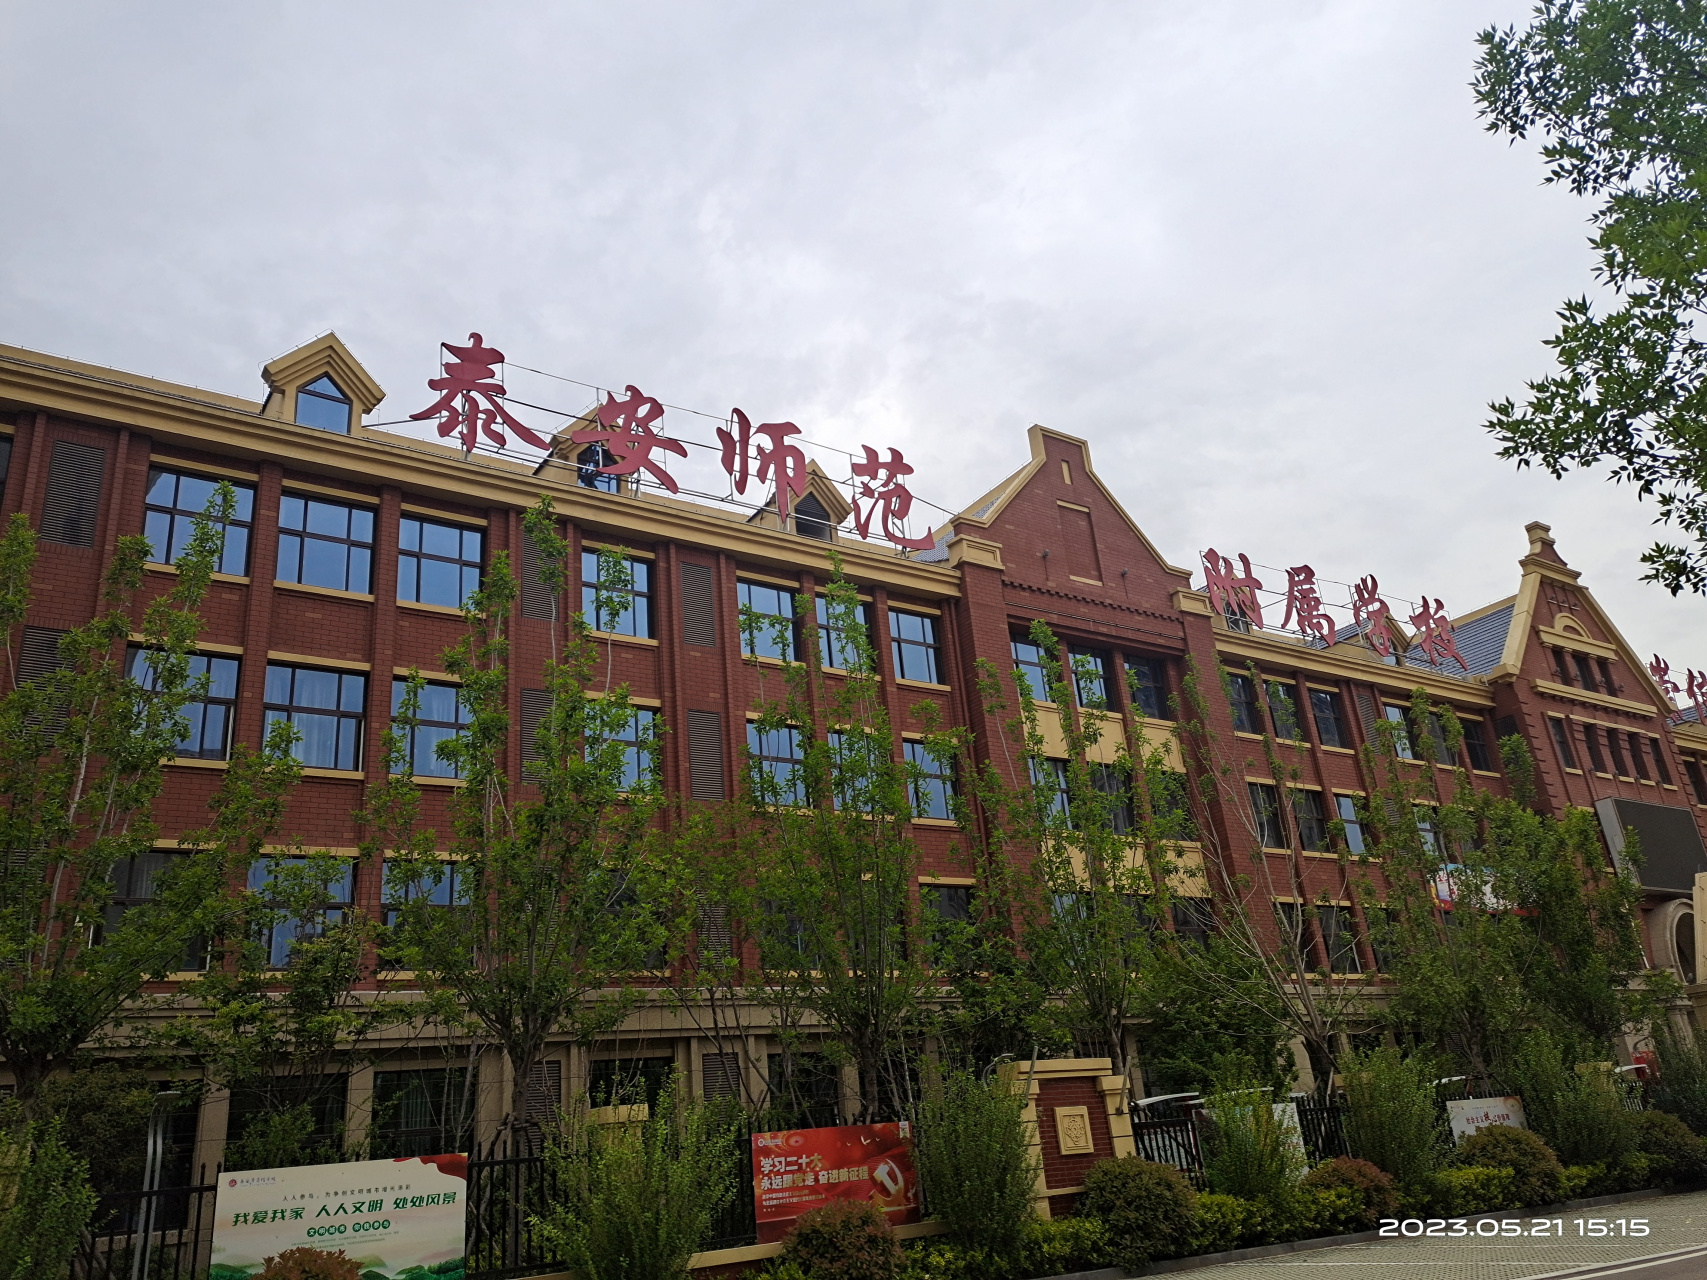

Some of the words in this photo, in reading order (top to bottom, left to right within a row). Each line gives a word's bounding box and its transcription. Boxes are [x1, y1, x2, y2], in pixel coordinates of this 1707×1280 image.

[410, 332, 935, 549] 泰安师范
[1203, 547, 1469, 671] 附属学校
[760, 1153, 823, 1175] 学习二十大
[760, 1172, 815, 1191] 永远跟党走
[818, 1165, 869, 1184] 奋进新征程
[232, 1207, 306, 1227] 我爱我家
[315, 1199, 384, 1218] 人人文明
[392, 1191, 457, 1211] 处处风景
[307, 1224, 347, 1237] 文明城市
